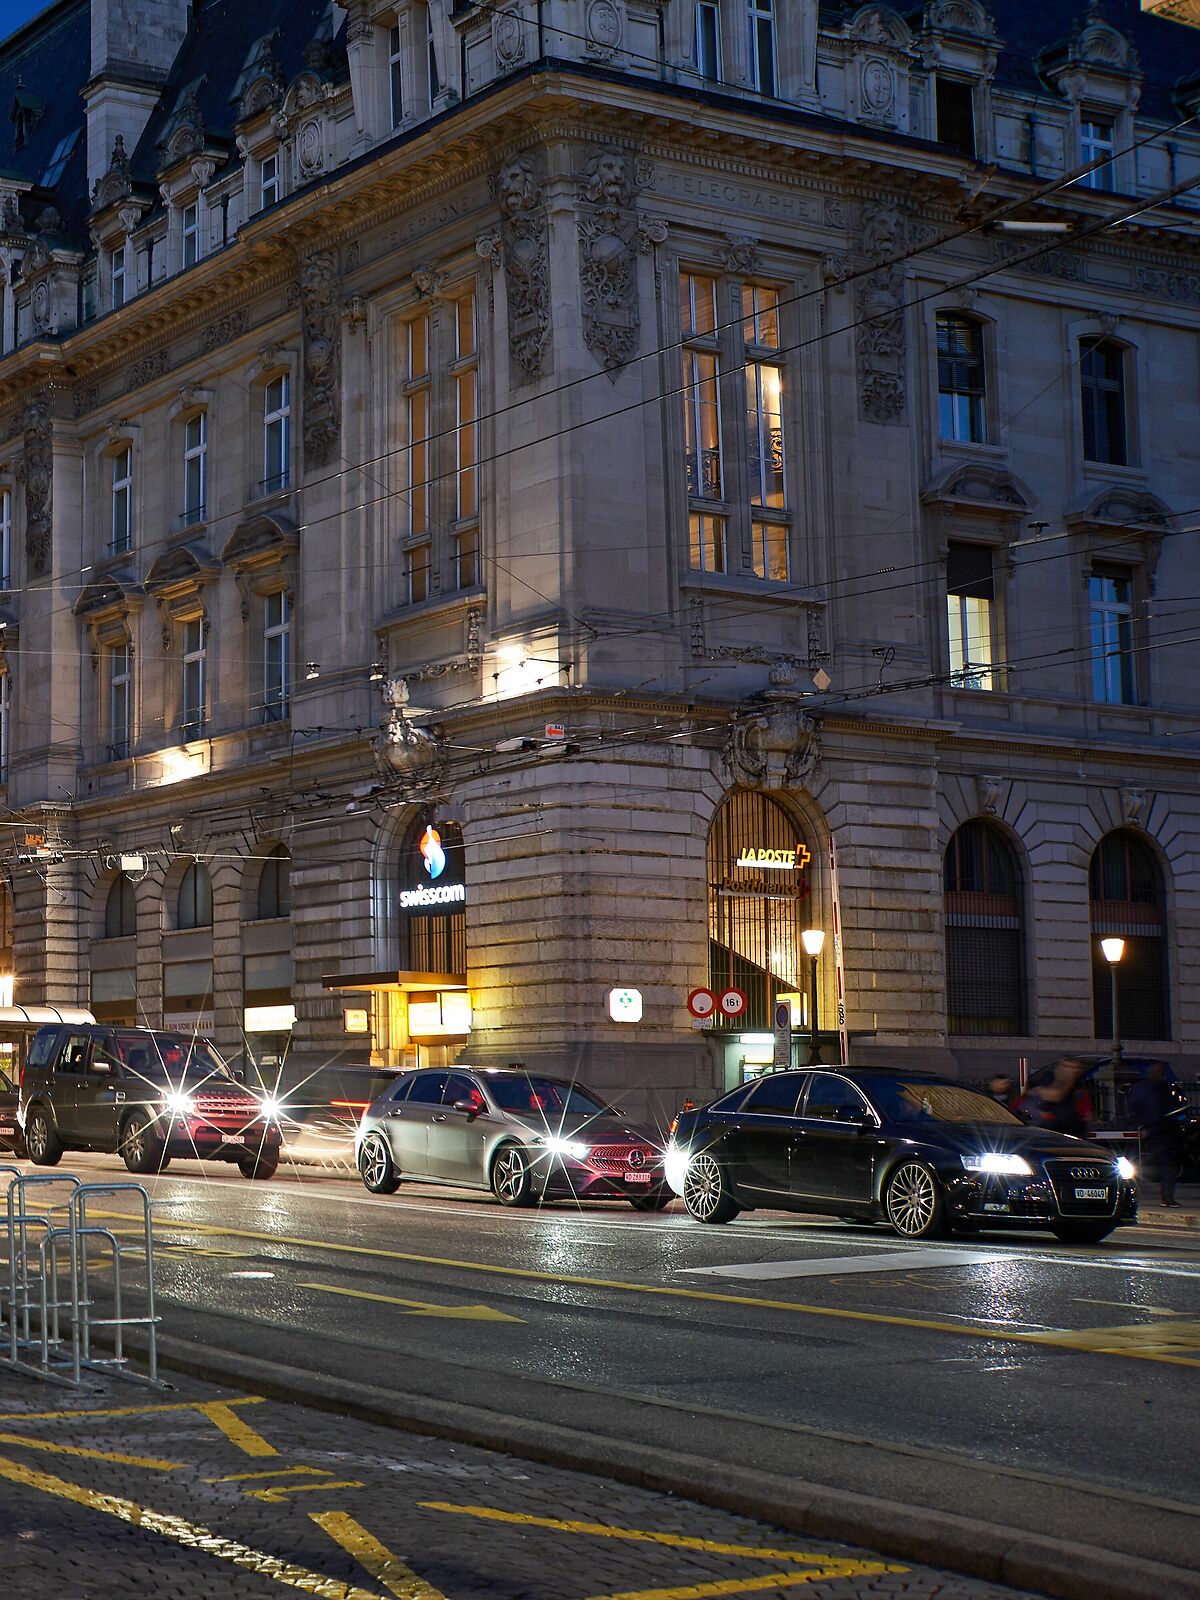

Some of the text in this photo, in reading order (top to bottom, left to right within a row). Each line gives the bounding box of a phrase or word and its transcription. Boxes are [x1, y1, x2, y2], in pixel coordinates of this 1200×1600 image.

[741, 847, 796, 864] LA POSTE
[400, 884, 465, 907] swisscom
